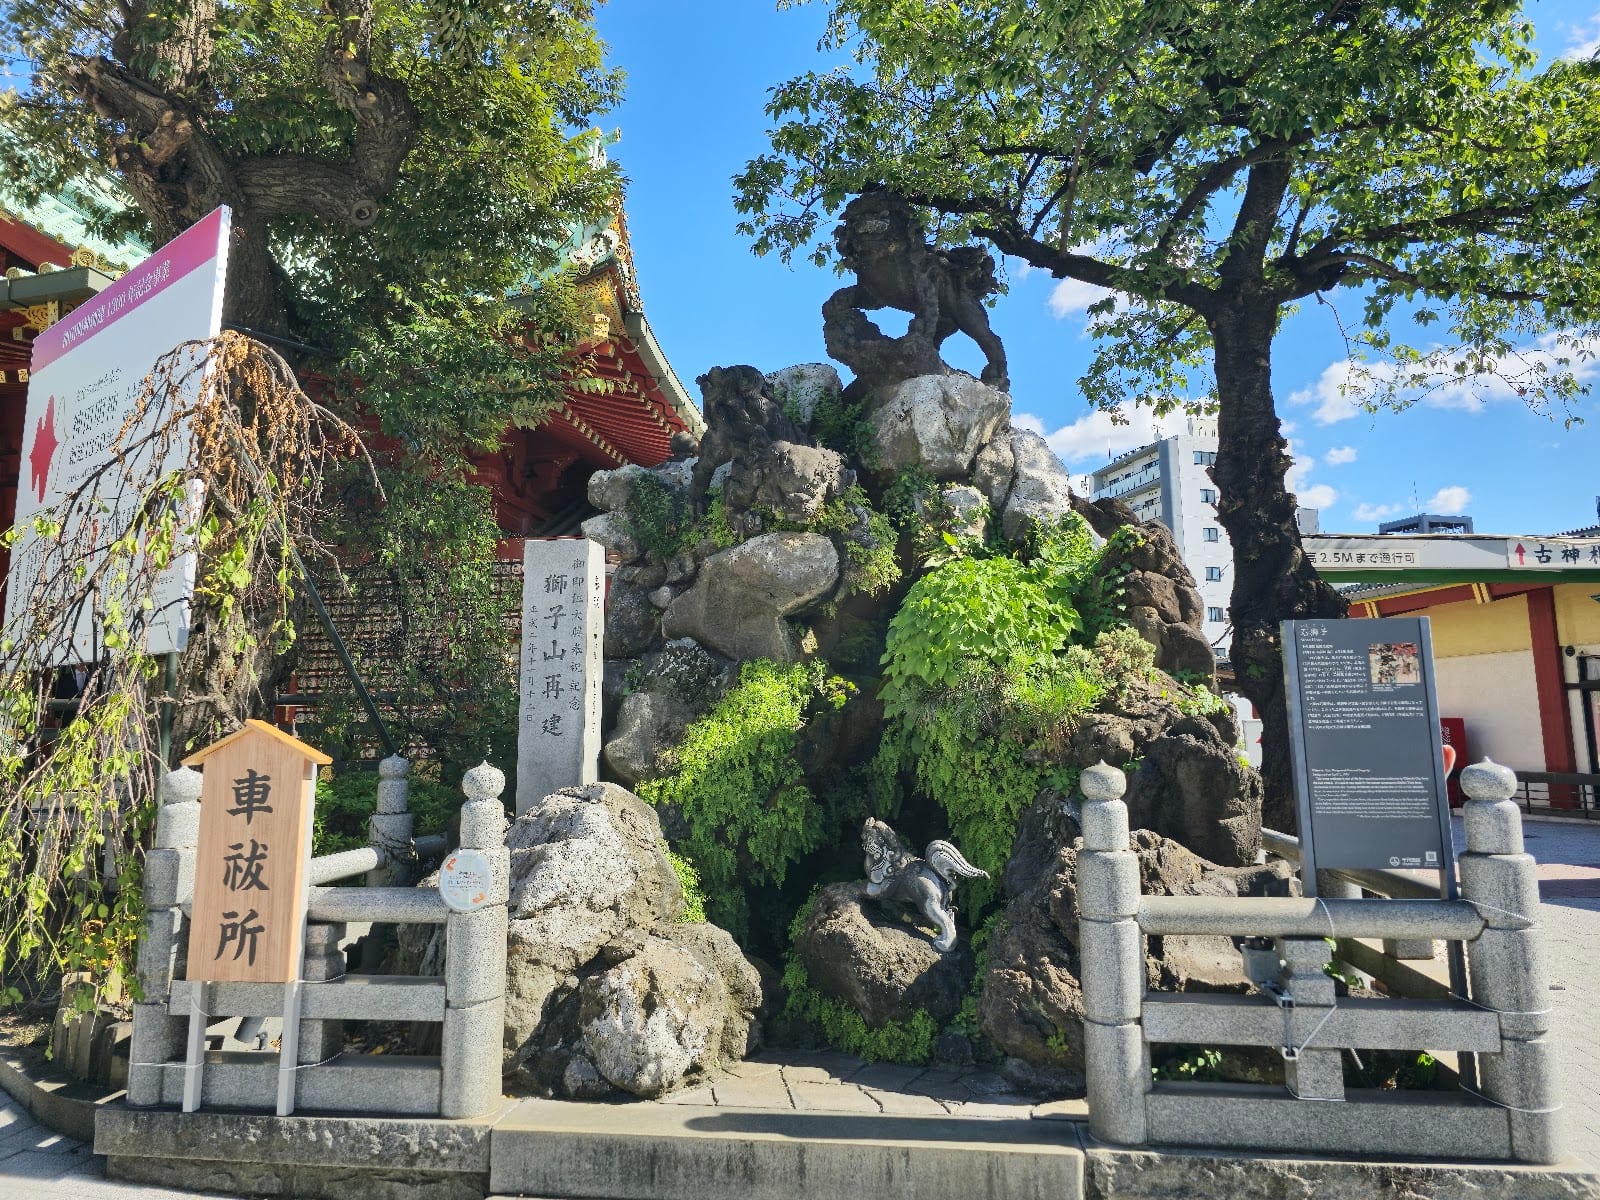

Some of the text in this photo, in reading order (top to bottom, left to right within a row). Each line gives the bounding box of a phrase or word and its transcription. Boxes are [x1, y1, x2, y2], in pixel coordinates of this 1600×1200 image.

[541, 573, 569, 737] 獅子山再建
[214, 768, 274, 967] 車祓所
